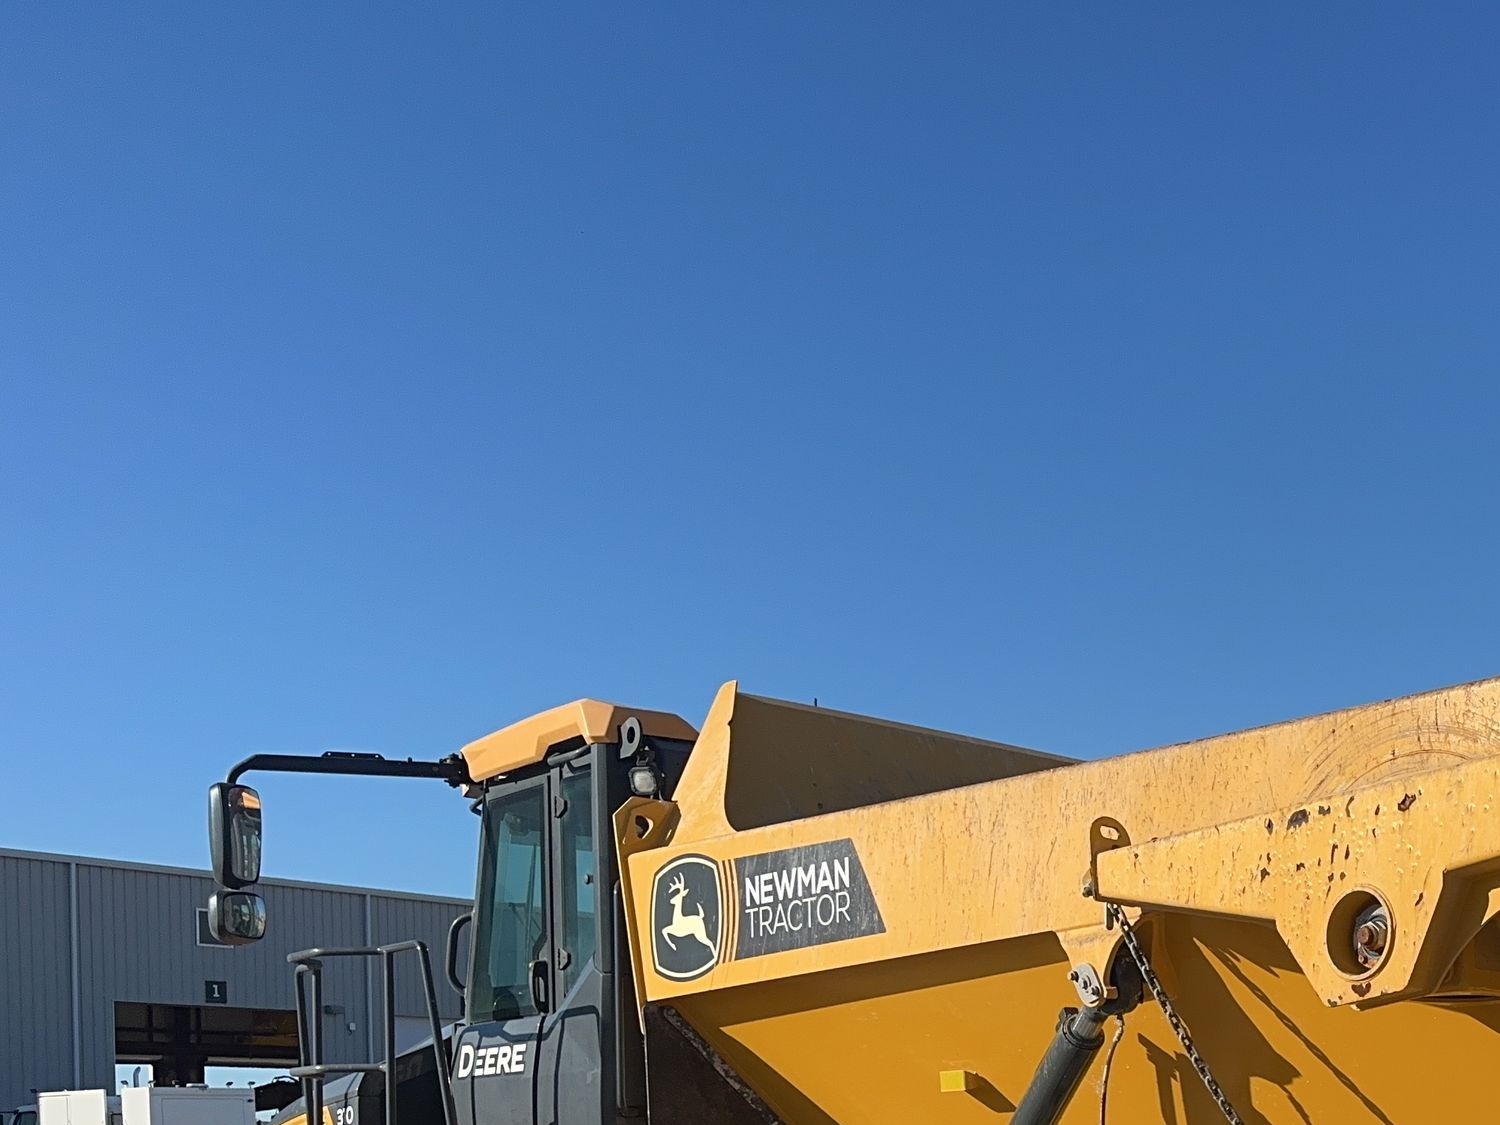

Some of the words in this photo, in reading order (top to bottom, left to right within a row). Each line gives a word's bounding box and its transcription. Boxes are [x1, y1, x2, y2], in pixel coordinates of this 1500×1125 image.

[745, 856, 850, 907] NEWMAN
[745, 891, 851, 938] TRACTOR
[212, 984, 220, 997] 1
[458, 1043, 527, 1078] DEERE
